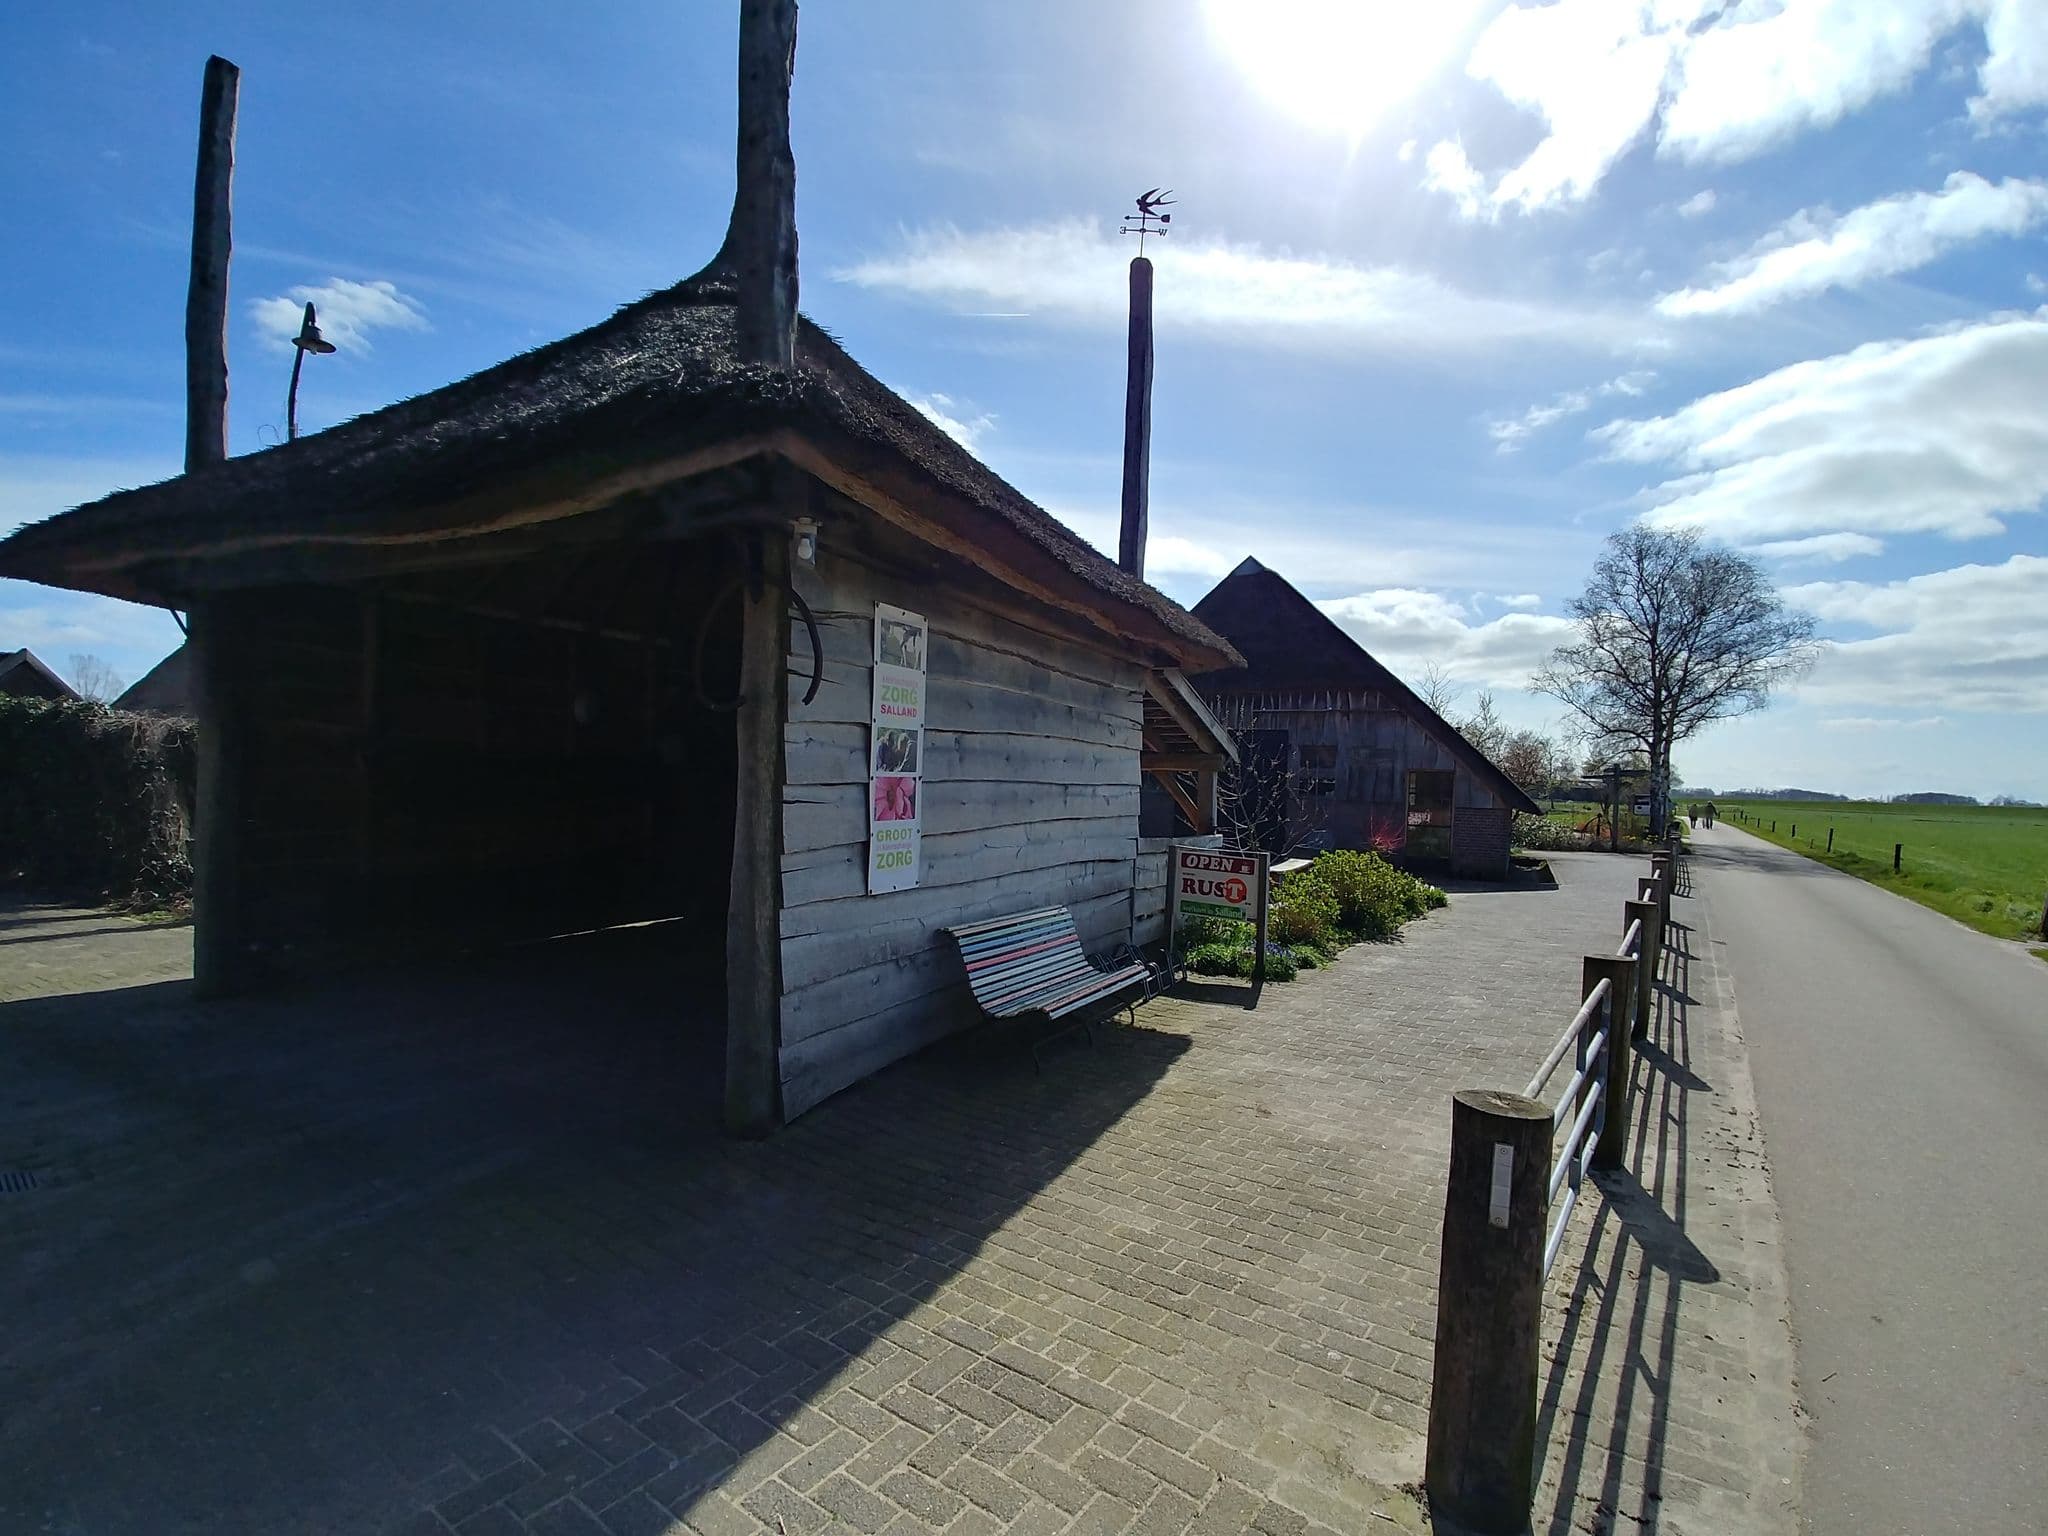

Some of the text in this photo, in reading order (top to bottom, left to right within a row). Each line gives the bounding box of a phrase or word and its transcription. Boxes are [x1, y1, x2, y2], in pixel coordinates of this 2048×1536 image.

[1158, 228, 1168, 237] W
[880, 684, 918, 705] ZORG
[880, 704, 918, 718] SALLAND
[876, 828, 913, 843] GROOT
[876, 851, 913, 870] ZORG
[1186, 855, 1234, 871] OPEN
[1181, 878, 1244, 900] RUST
[1215, 907, 1243, 919] Salland
